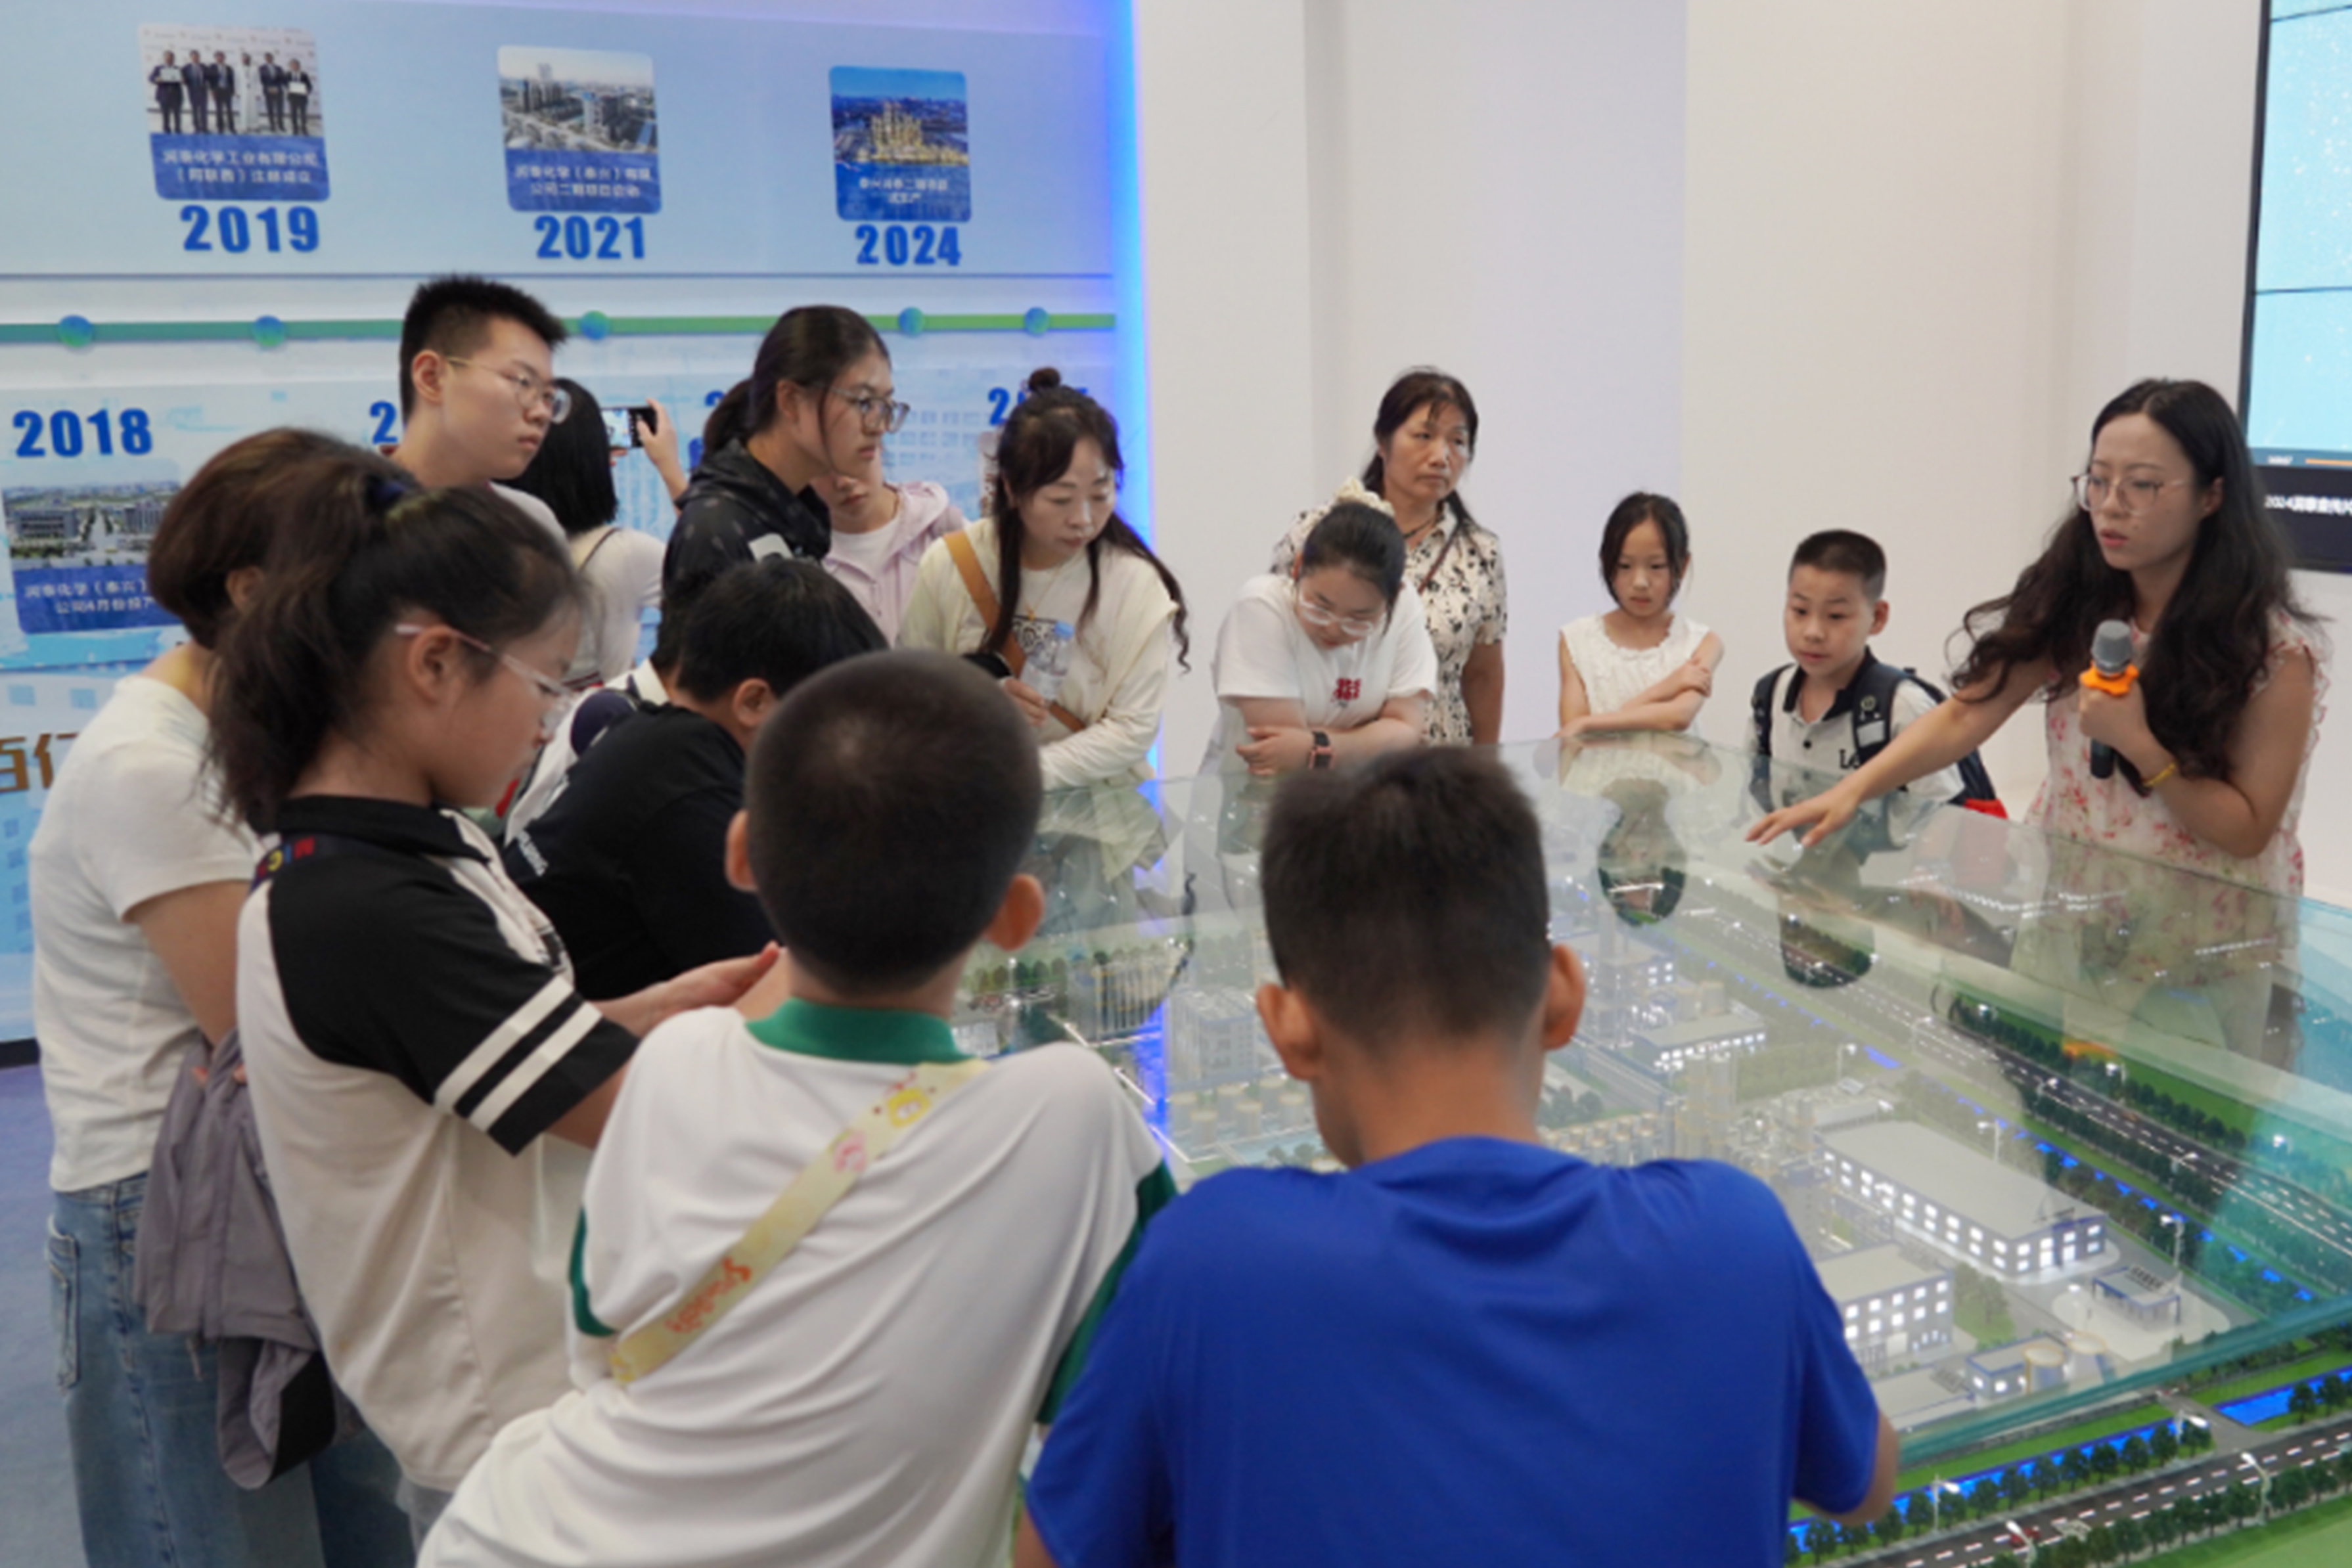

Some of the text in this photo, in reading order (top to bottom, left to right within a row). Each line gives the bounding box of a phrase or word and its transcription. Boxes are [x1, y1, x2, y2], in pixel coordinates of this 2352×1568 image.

[179, 204, 320, 254] 2019
[534, 215, 645, 259] 2021
[855, 224, 962, 267] 2024
[12, 408, 152, 458] 2018
